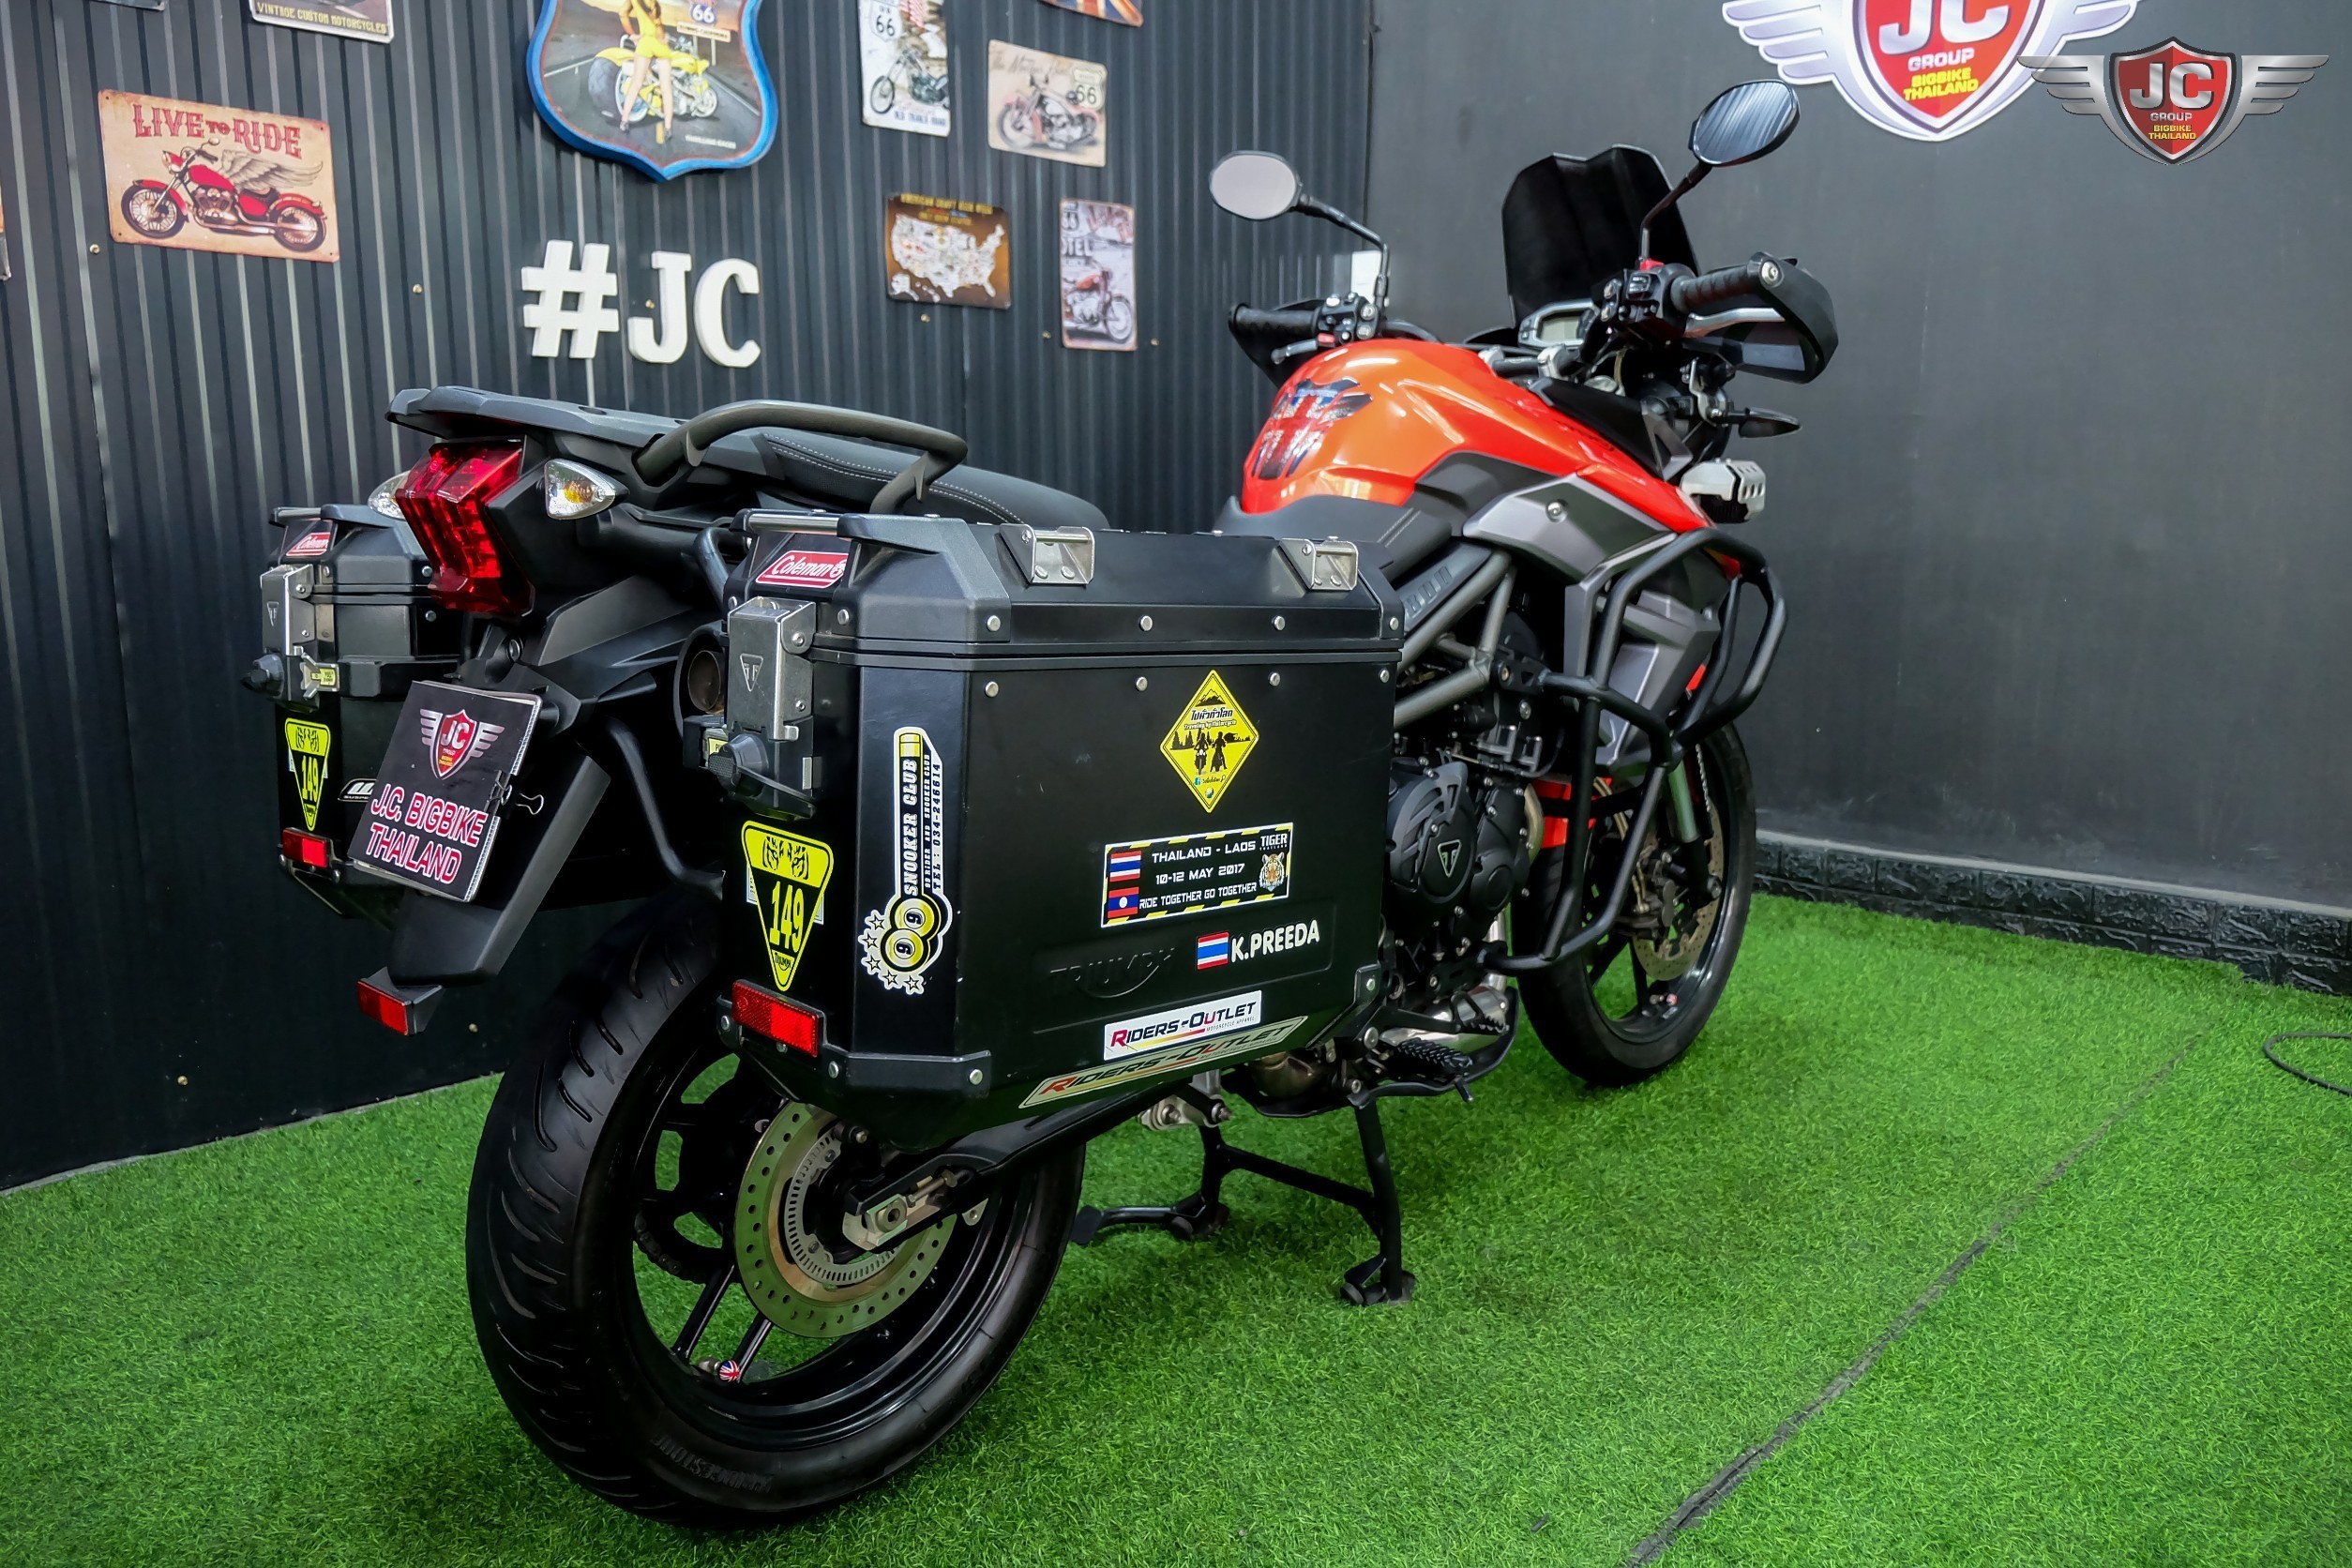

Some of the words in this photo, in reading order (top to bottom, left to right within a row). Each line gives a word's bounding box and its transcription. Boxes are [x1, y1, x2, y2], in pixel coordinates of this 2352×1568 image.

[256, 2, 296, 19] VINTAGE
[297, 8, 329, 24] CUSTOM
[331, 14, 387, 34] MOTORCYCLES
[692, 4, 716, 23] 66
[876, 15, 896, 37] 66
[1879, 0, 2010, 54] JC
[1907, 47, 1975, 71] GROUP
[1903, 79, 1979, 101] THAILAND
[1911, 67, 1971, 87] BIGBIKE
[1076, 84, 1097, 105] 66
[132, 103, 204, 139] LIVE
[205, 120, 231, 135] TO
[233, 117, 302, 159] RIDE
[772, 554, 832, 578] Coleman
[441, 720, 470, 749] JC
[302, 755, 318, 802] 149
[923, 754, 931, 777] CLUB
[902, 759, 918, 807] CLUB
[923, 778, 931, 819] SNOOKER
[932, 763, 941, 847] 034-246614
[404, 792, 489, 848] BIGBIKE
[366, 822, 462, 884] THAILAND
[1152, 846, 1212, 864] THAILAND
[1225, 840, 1257, 854] LAOS
[1260, 833, 1288, 847] TIGER
[903, 813, 919, 897] SNOOKER
[924, 878, 931, 889] 99
[932, 862, 942, 890] TEL
[1155, 871, 1185, 885] 10-12
[1188, 867, 1214, 881] MAY
[1218, 863, 1245, 876] 2017
[1139, 897, 1158, 910] RIDE
[1160, 890, 1202, 906] TOGETHER
[1204, 887, 1215, 899] GO
[1218, 882, 1258, 897] TOGETHER
[769, 881, 805, 954] 149
[906, 912, 924, 925] 9
[896, 942, 913, 955] 9
[1230, 919, 1321, 964] K.PREEDA
